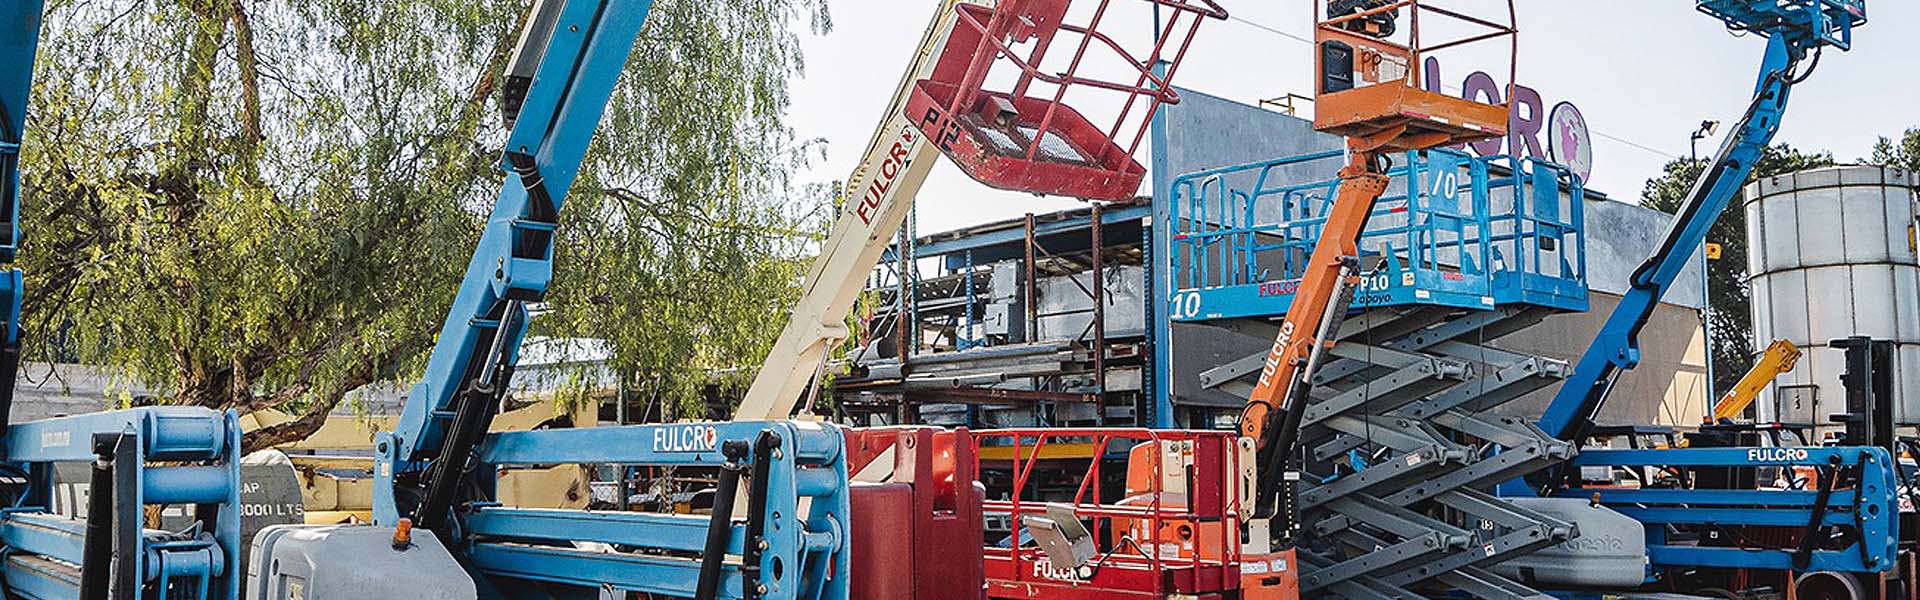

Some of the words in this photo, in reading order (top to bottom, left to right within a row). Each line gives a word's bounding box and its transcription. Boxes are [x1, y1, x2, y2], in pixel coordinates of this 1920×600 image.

[919, 106, 961, 152] P12
[1360, 275, 1389, 291] P10
[1170, 291, 1201, 319] 10
[1259, 320, 1295, 388] FULCRO
[653, 425, 717, 452] FULCRO
[1748, 448, 1808, 461] FULCRO
[240, 482, 265, 494] AP.
[276, 503, 304, 516] LTS
